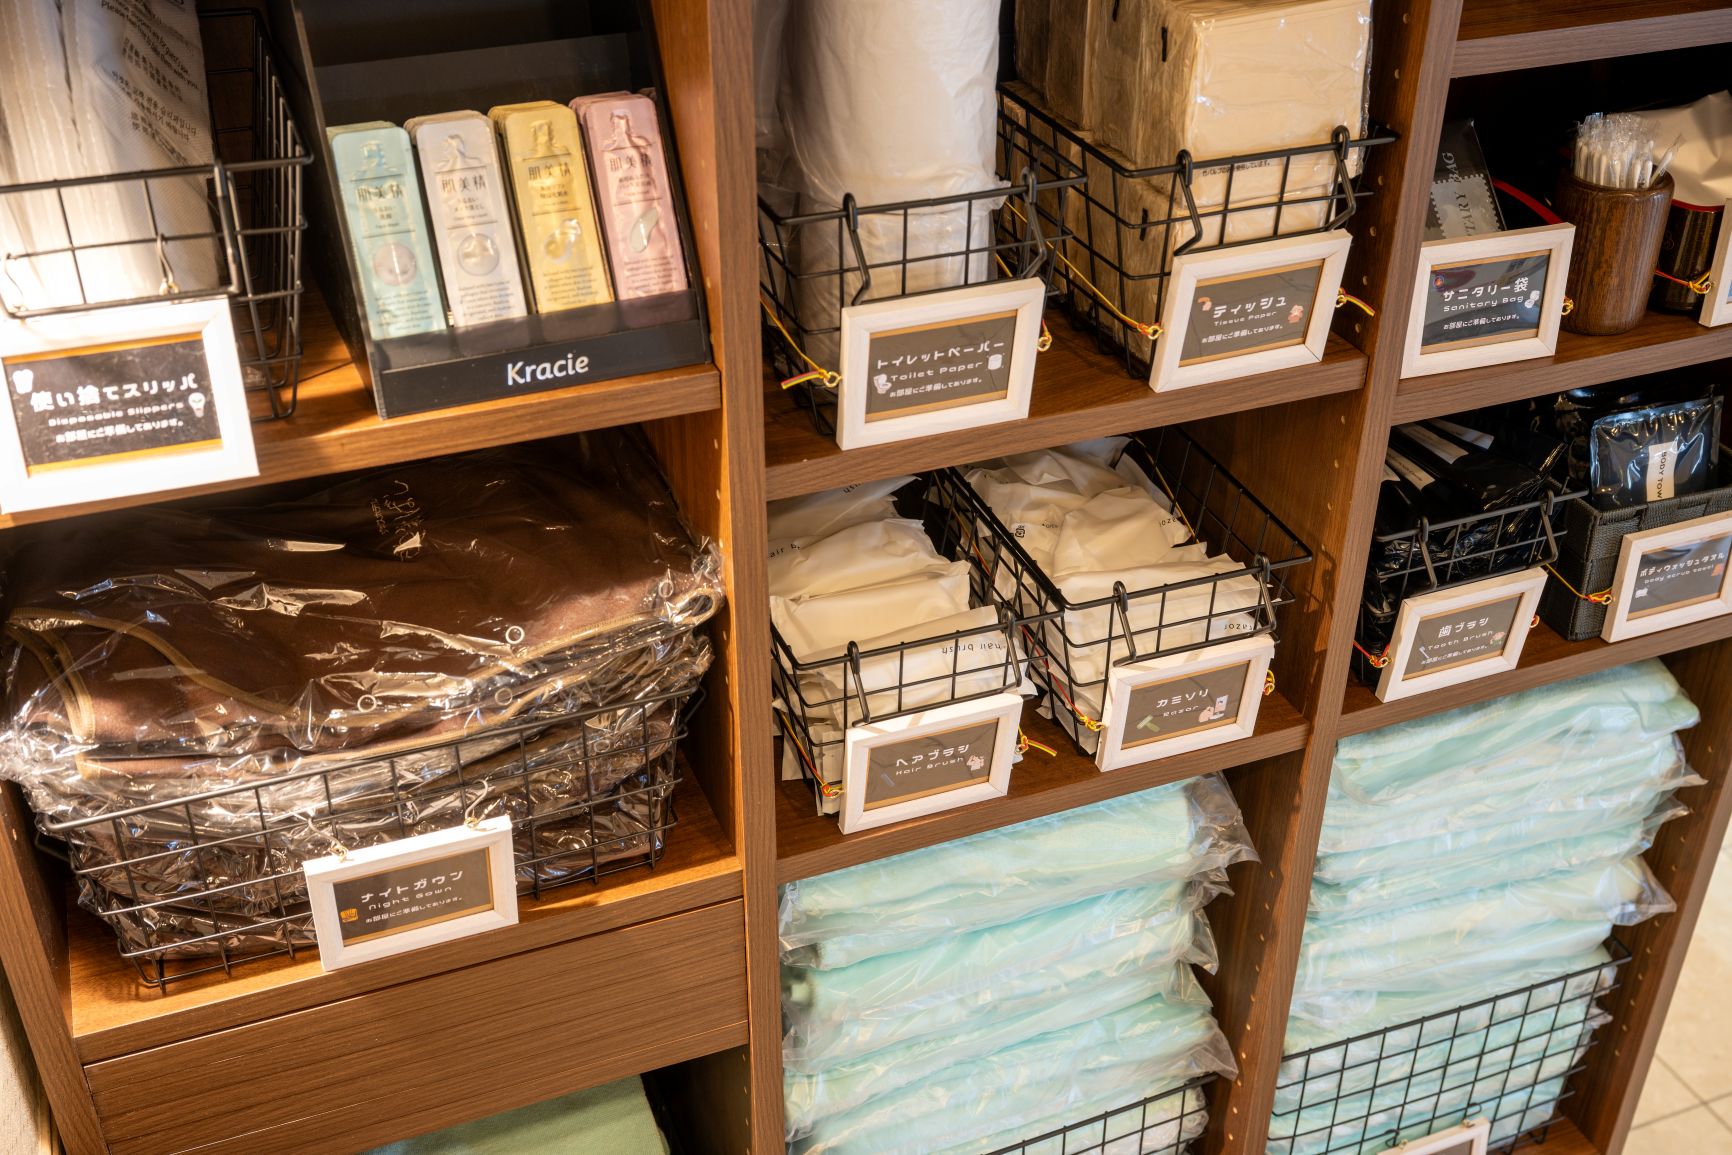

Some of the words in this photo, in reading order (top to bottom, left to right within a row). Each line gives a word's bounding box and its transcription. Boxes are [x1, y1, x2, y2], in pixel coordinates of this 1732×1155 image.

[441, 174, 486, 192] 肌美精
[1454, 192, 1476, 235] TARY
[1443, 277, 1529, 302] サニタリー袋
[1213, 296, 1287, 318] ティッシュ
[1443, 299, 1498, 312] Sanitary
[1502, 295, 1524, 305] Bag
[1213, 317, 1246, 327] Tissue
[1248, 311, 1277, 320] Paper
[1443, 314, 1520, 330] お部屋にご準備しております。
[1202, 324, 1283, 343] お部屋にご準備しております。
[877, 340, 1005, 370] トイレットペーパー
[506, 352, 590, 387] Kracie
[891, 369, 935, 382] Toilet
[939, 361, 984, 375] Paper
[30, 372, 199, 413] 使い捨てスリッパ
[889, 378, 982, 398] お部屋にご準備しております。
[48, 410, 124, 427] Disposable
[127, 401, 185, 416] Slippers
[55, 418, 184, 443] お部屋にご準備しております。
[769, 548, 784, 558] air
[1438, 617, 1489, 638] 歯ブラシ
[1428, 639, 1459, 651] Tooth
[1463, 631, 1493, 642] Brush
[1156, 688, 1210, 708] カミソリ
[1163, 705, 1199, 717] Razor
[896, 744, 970, 767] ヘアブラシ
[896, 766, 922, 776] Hair
[926, 757, 964, 769] Brush
[361, 871, 464, 903] ナイトガウン
[415, 886, 453, 900] Gown
[365, 896, 463, 923] お部屋にご準備しております。
